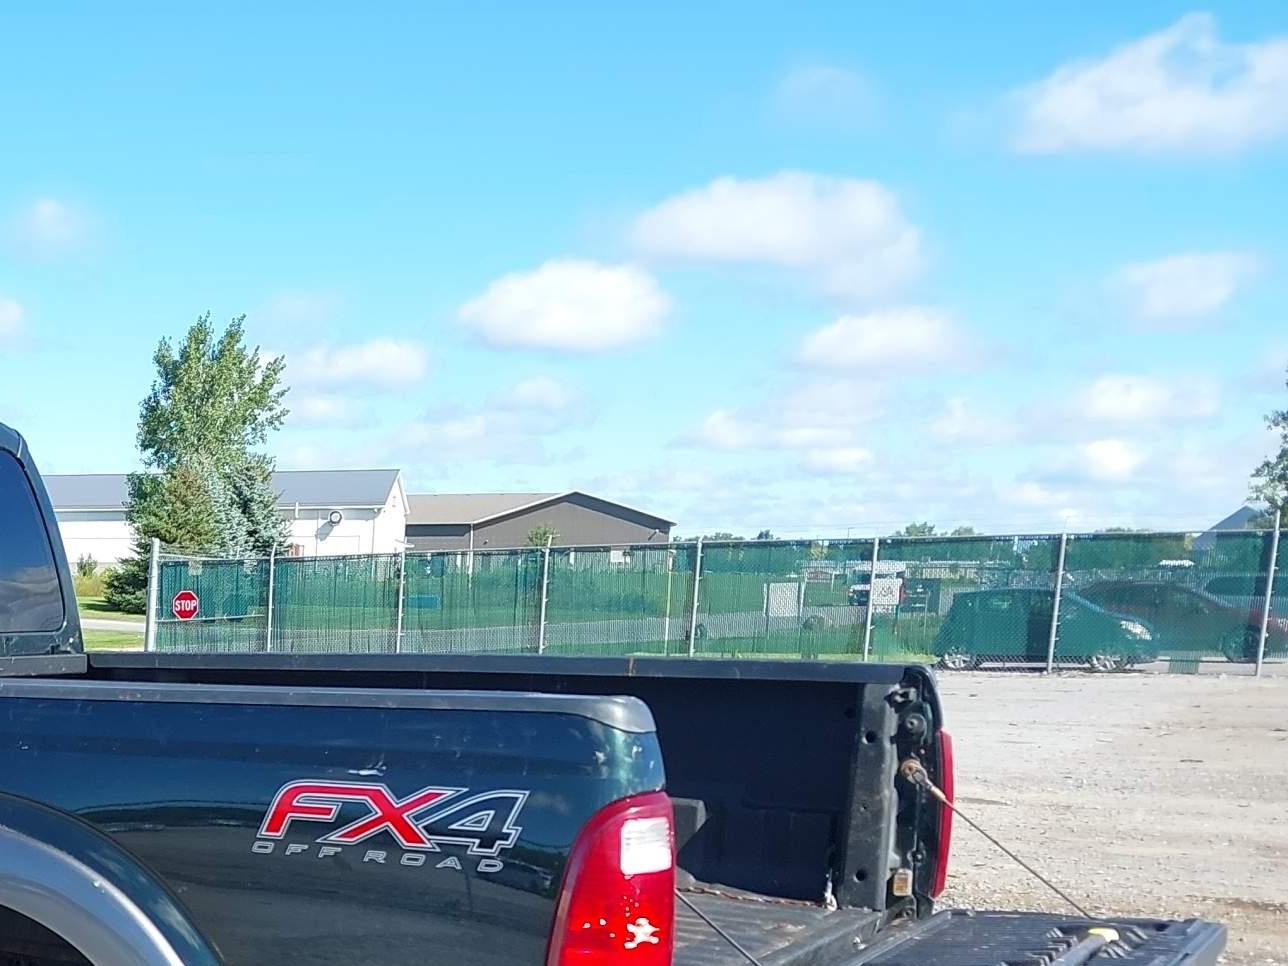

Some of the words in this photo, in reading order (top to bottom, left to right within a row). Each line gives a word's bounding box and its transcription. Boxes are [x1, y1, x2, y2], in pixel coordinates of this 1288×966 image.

[175, 599, 197, 612] STOP
[256, 779, 530, 856] FX4
[252, 841, 342, 858] OFF
[363, 850, 504, 873] ROAD
